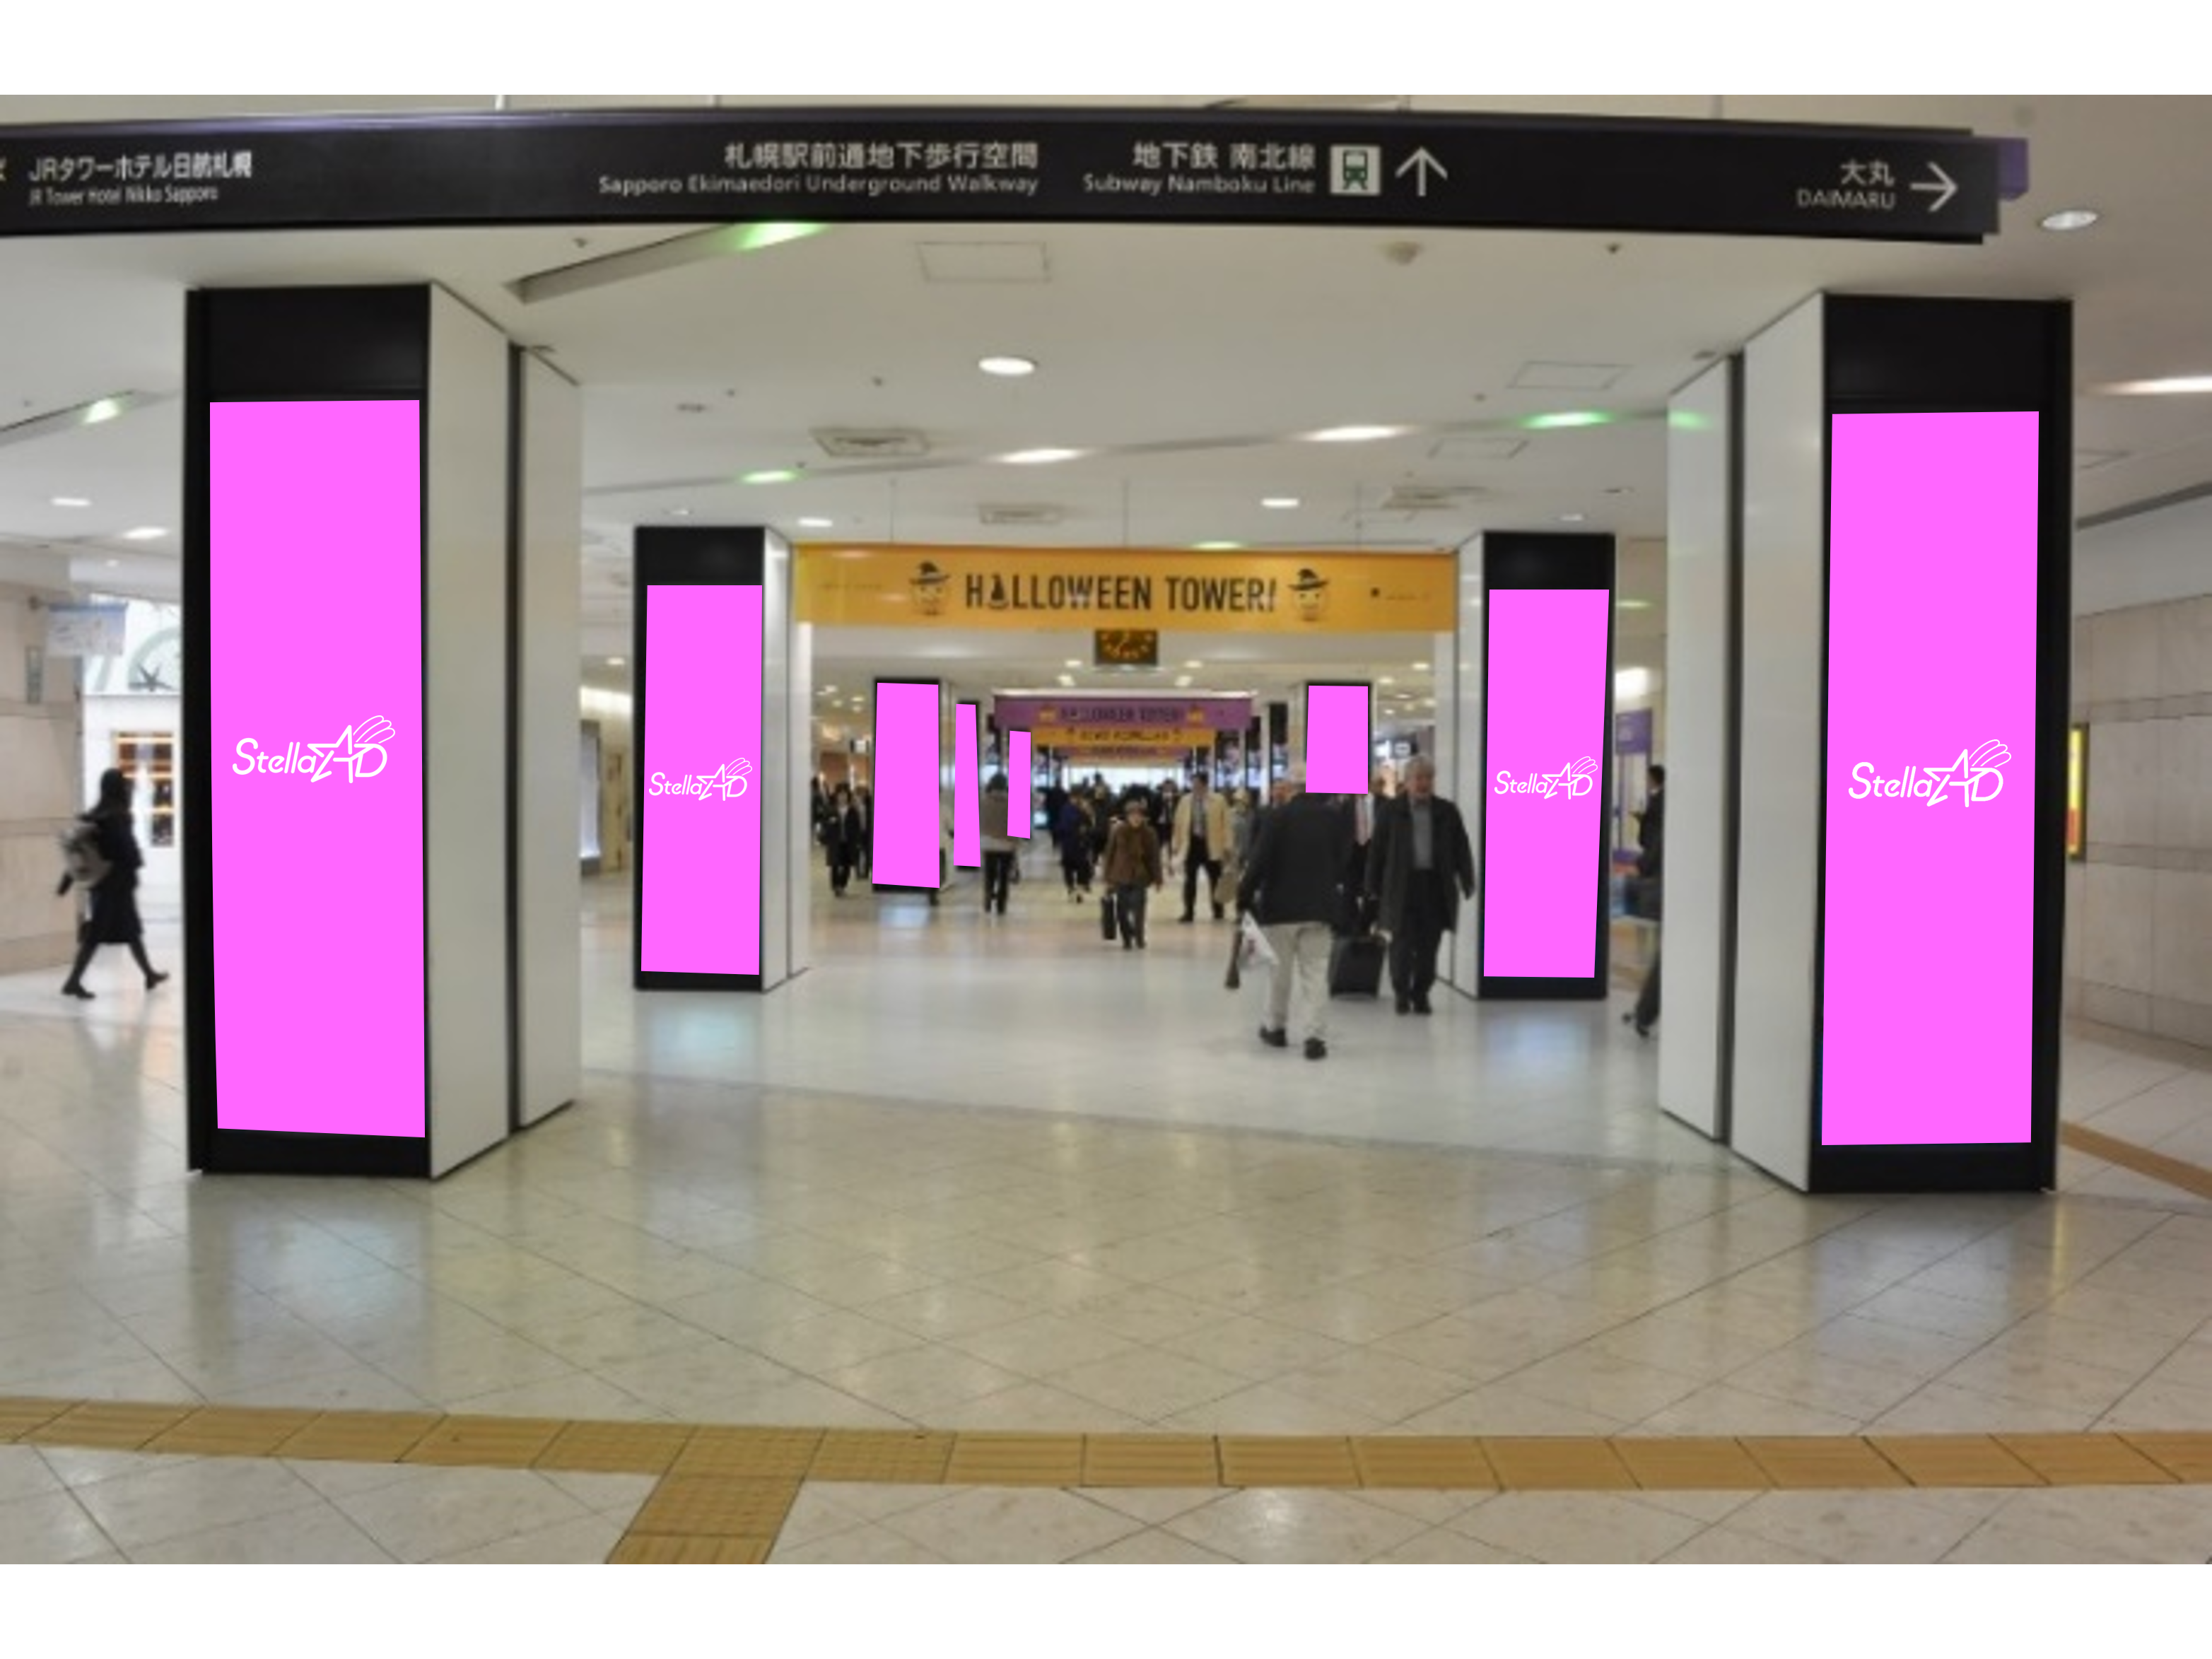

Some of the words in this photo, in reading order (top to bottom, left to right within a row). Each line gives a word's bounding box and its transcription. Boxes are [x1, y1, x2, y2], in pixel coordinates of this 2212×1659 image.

[28, 150, 252, 181] JRタワーホテル日航札幌
[725, 141, 1038, 169] 札幌駅前通地下歩行空間
[1133, 141, 1218, 169] 地下鉄
[1229, 142, 1316, 170] 南北線
[599, 176, 683, 197] Sapporo
[688, 175, 800, 193] Ekimaedori
[805, 175, 941, 197] Underground
[948, 175, 1038, 197] Walkway
[1083, 173, 1162, 197] Subway
[1168, 175, 1267, 194] Namboku
[1273, 175, 1316, 194] Line
[1840, 159, 1895, 187] 大丸
[1796, 188, 1896, 210] DAIMARU
[966, 574, 1152, 610] HALLOWEEN
